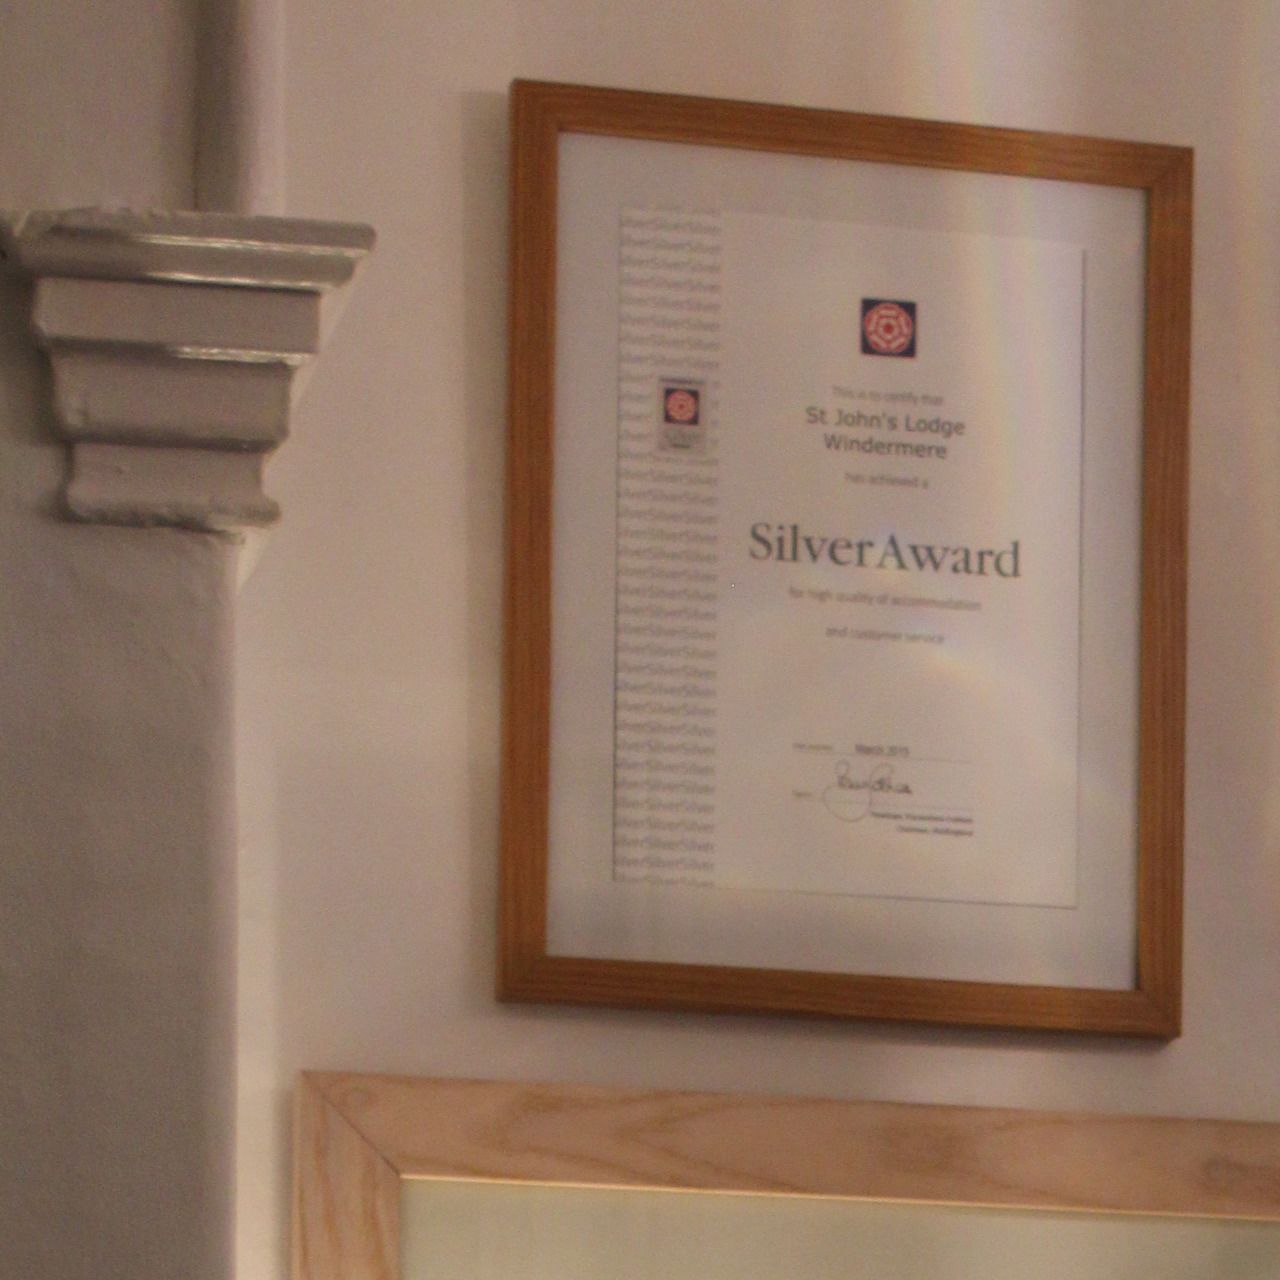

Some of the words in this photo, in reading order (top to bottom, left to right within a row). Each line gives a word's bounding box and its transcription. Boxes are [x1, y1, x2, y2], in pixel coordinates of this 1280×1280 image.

[806, 406, 827, 425] St
[835, 409, 897, 430] John's
[905, 415, 965, 438] Lodge
[824, 433, 947, 459] Windermere
